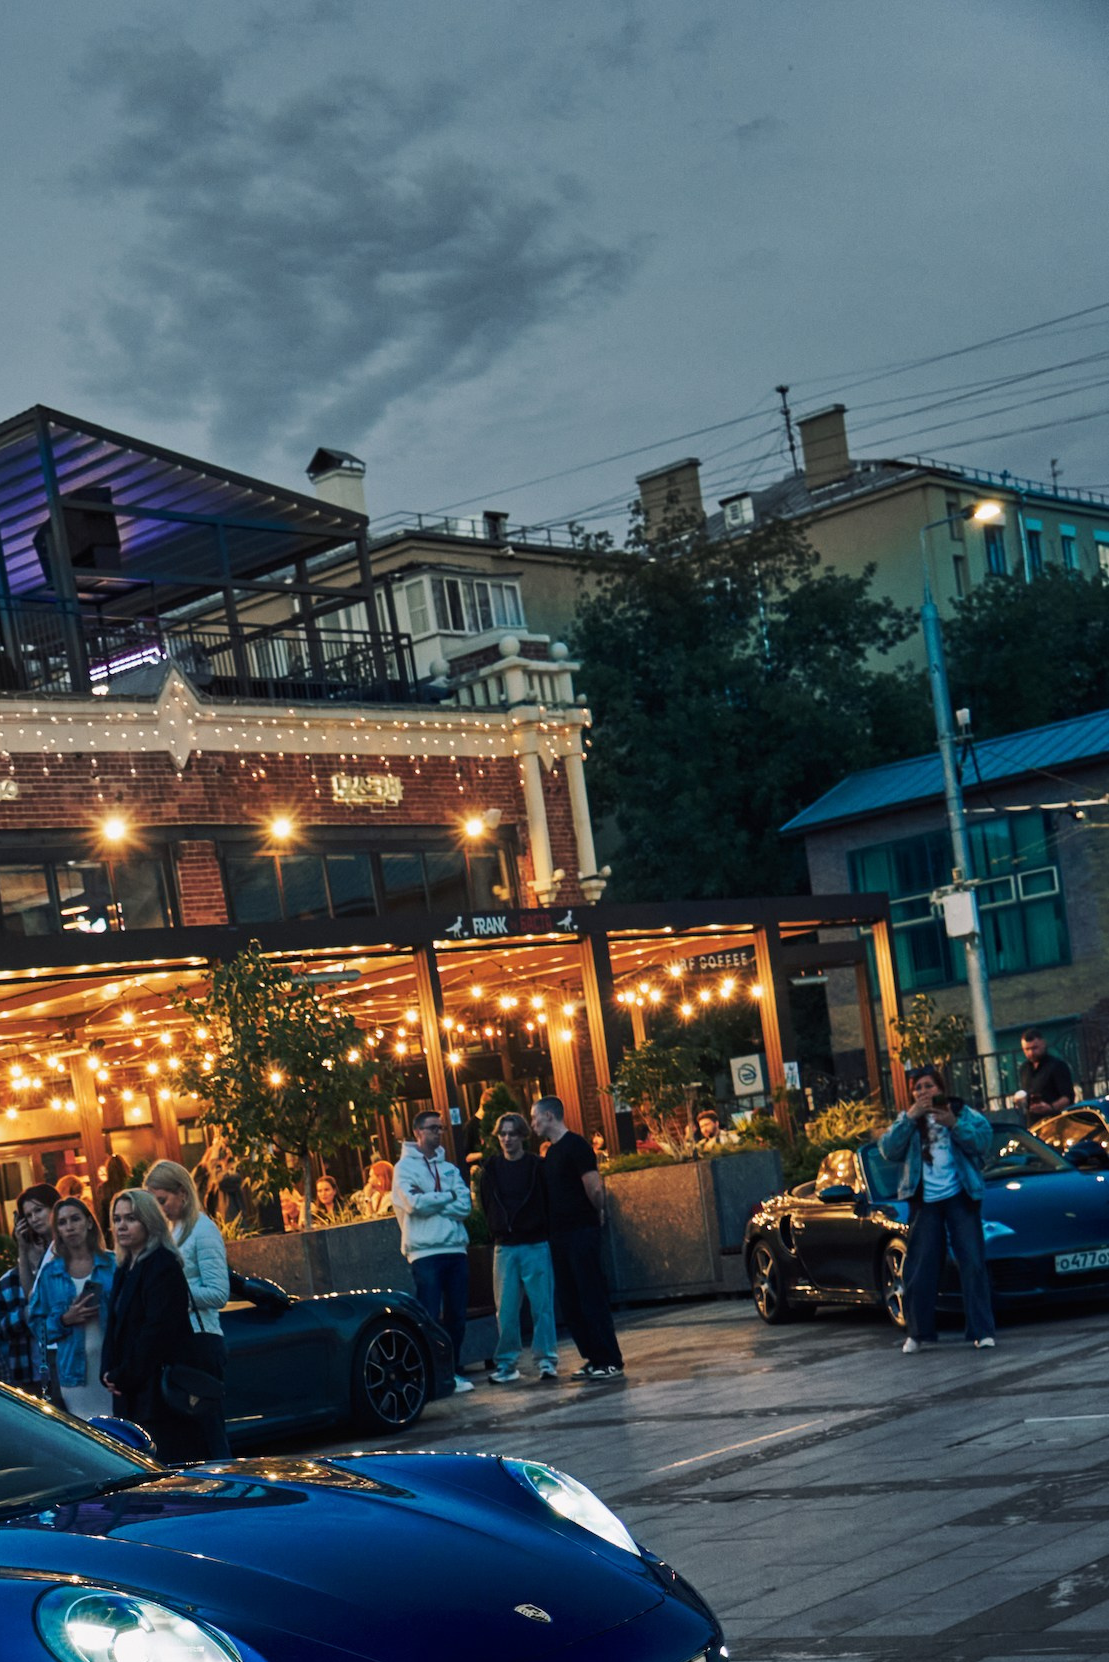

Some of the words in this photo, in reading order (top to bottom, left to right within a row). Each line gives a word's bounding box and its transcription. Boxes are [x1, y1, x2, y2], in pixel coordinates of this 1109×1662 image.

[472, 915, 509, 936] FRANK
[699, 952, 748, 970] COFFEE
[1060, 1251, 1109, 1270] О477О
